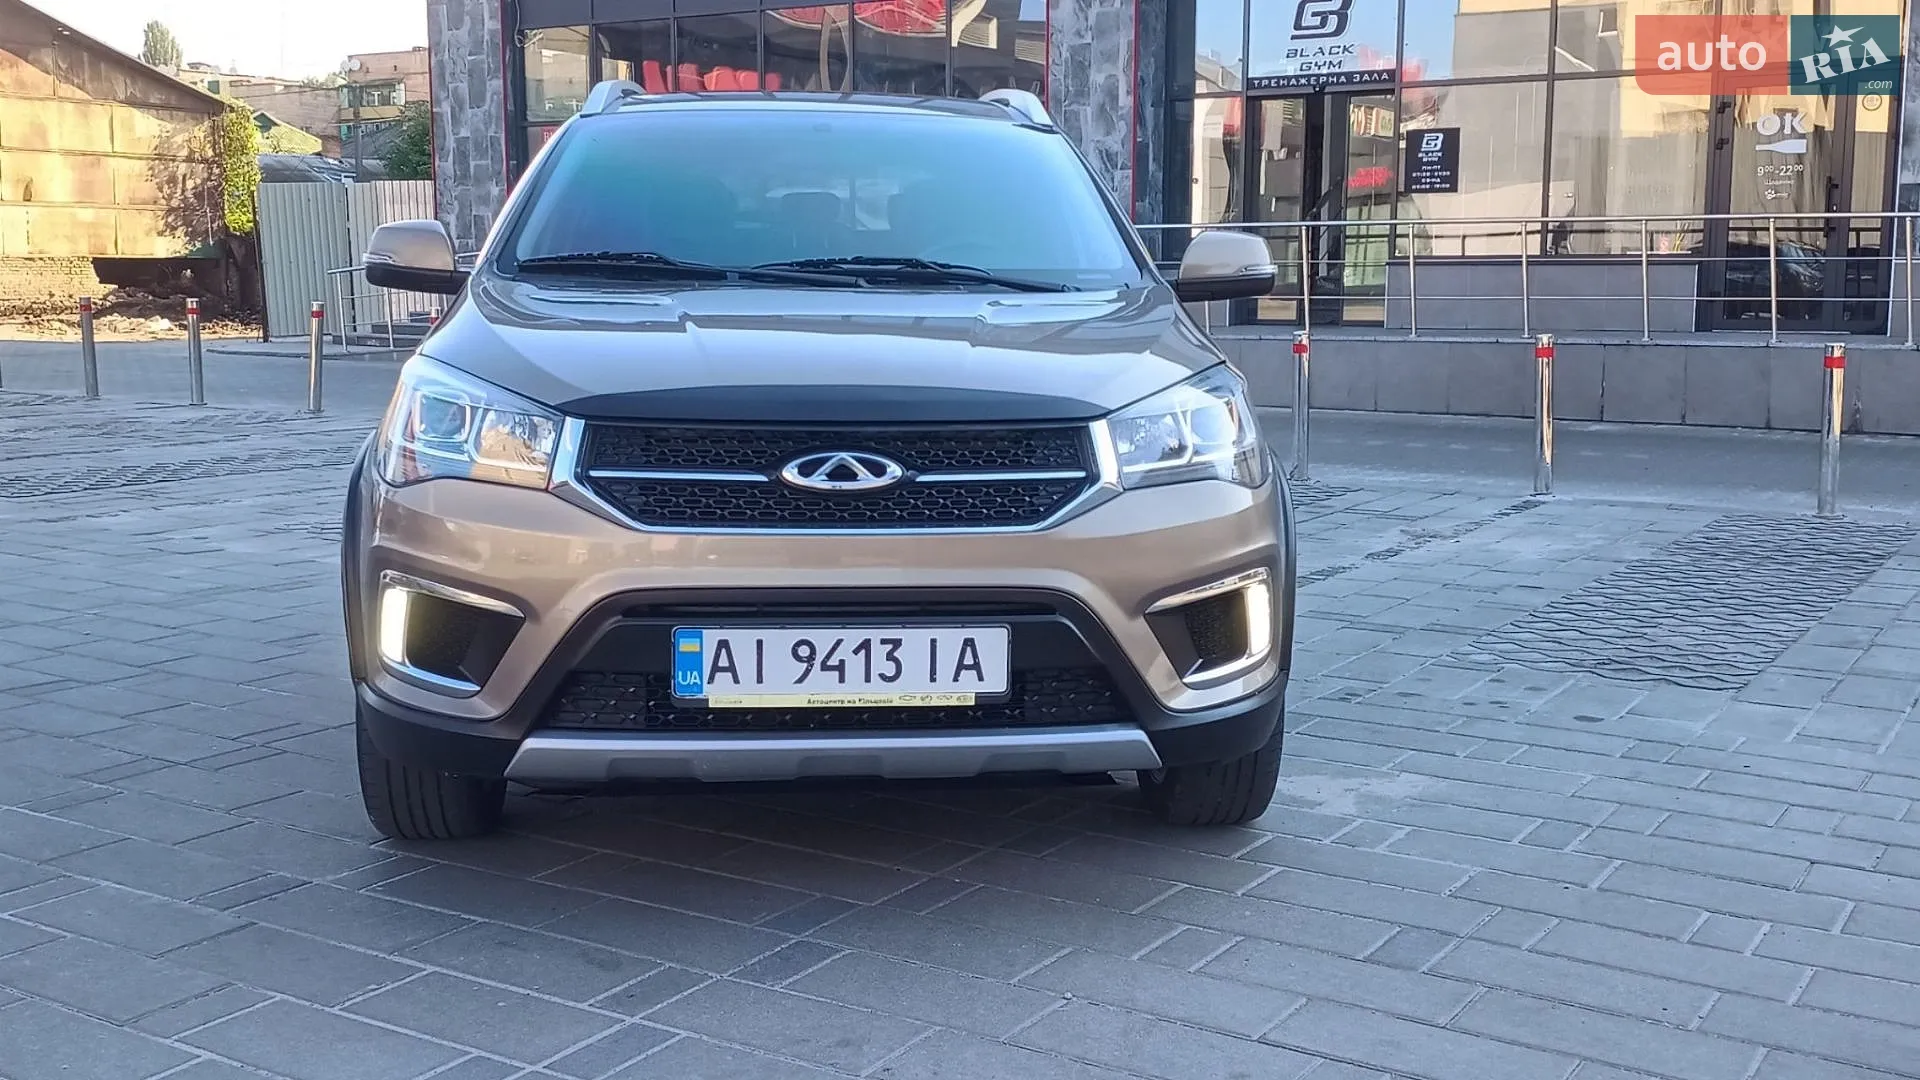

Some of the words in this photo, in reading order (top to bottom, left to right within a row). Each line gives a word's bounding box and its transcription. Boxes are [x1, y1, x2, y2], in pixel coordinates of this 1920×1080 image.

[1286, 43, 1355, 59] BLACK
[1299, 59, 1343, 72] GYM
[1253, 75, 1347, 88] ТРЕНАЖЕРНА
[1352, 72, 1390, 82] ЗАЛА
[790, 637, 903, 685] 9413
[678, 672, 701, 685] UA
